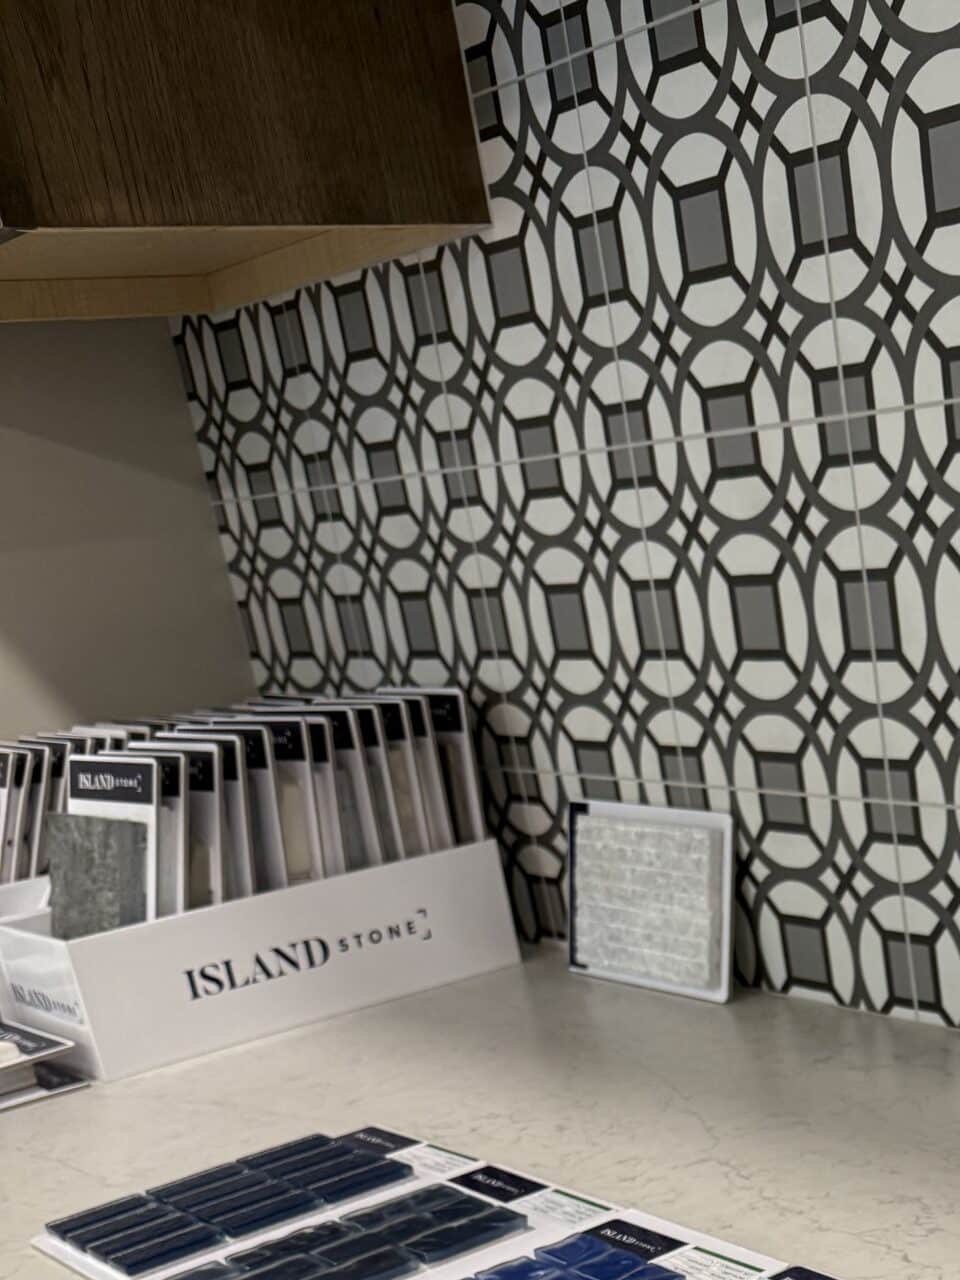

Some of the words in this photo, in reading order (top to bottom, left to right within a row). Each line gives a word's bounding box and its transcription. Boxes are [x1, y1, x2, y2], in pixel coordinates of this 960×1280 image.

[78, 772, 114, 790] ISLAND
[183, 936, 330, 1001] ISLAND
[337, 920, 418, 953] STONE
